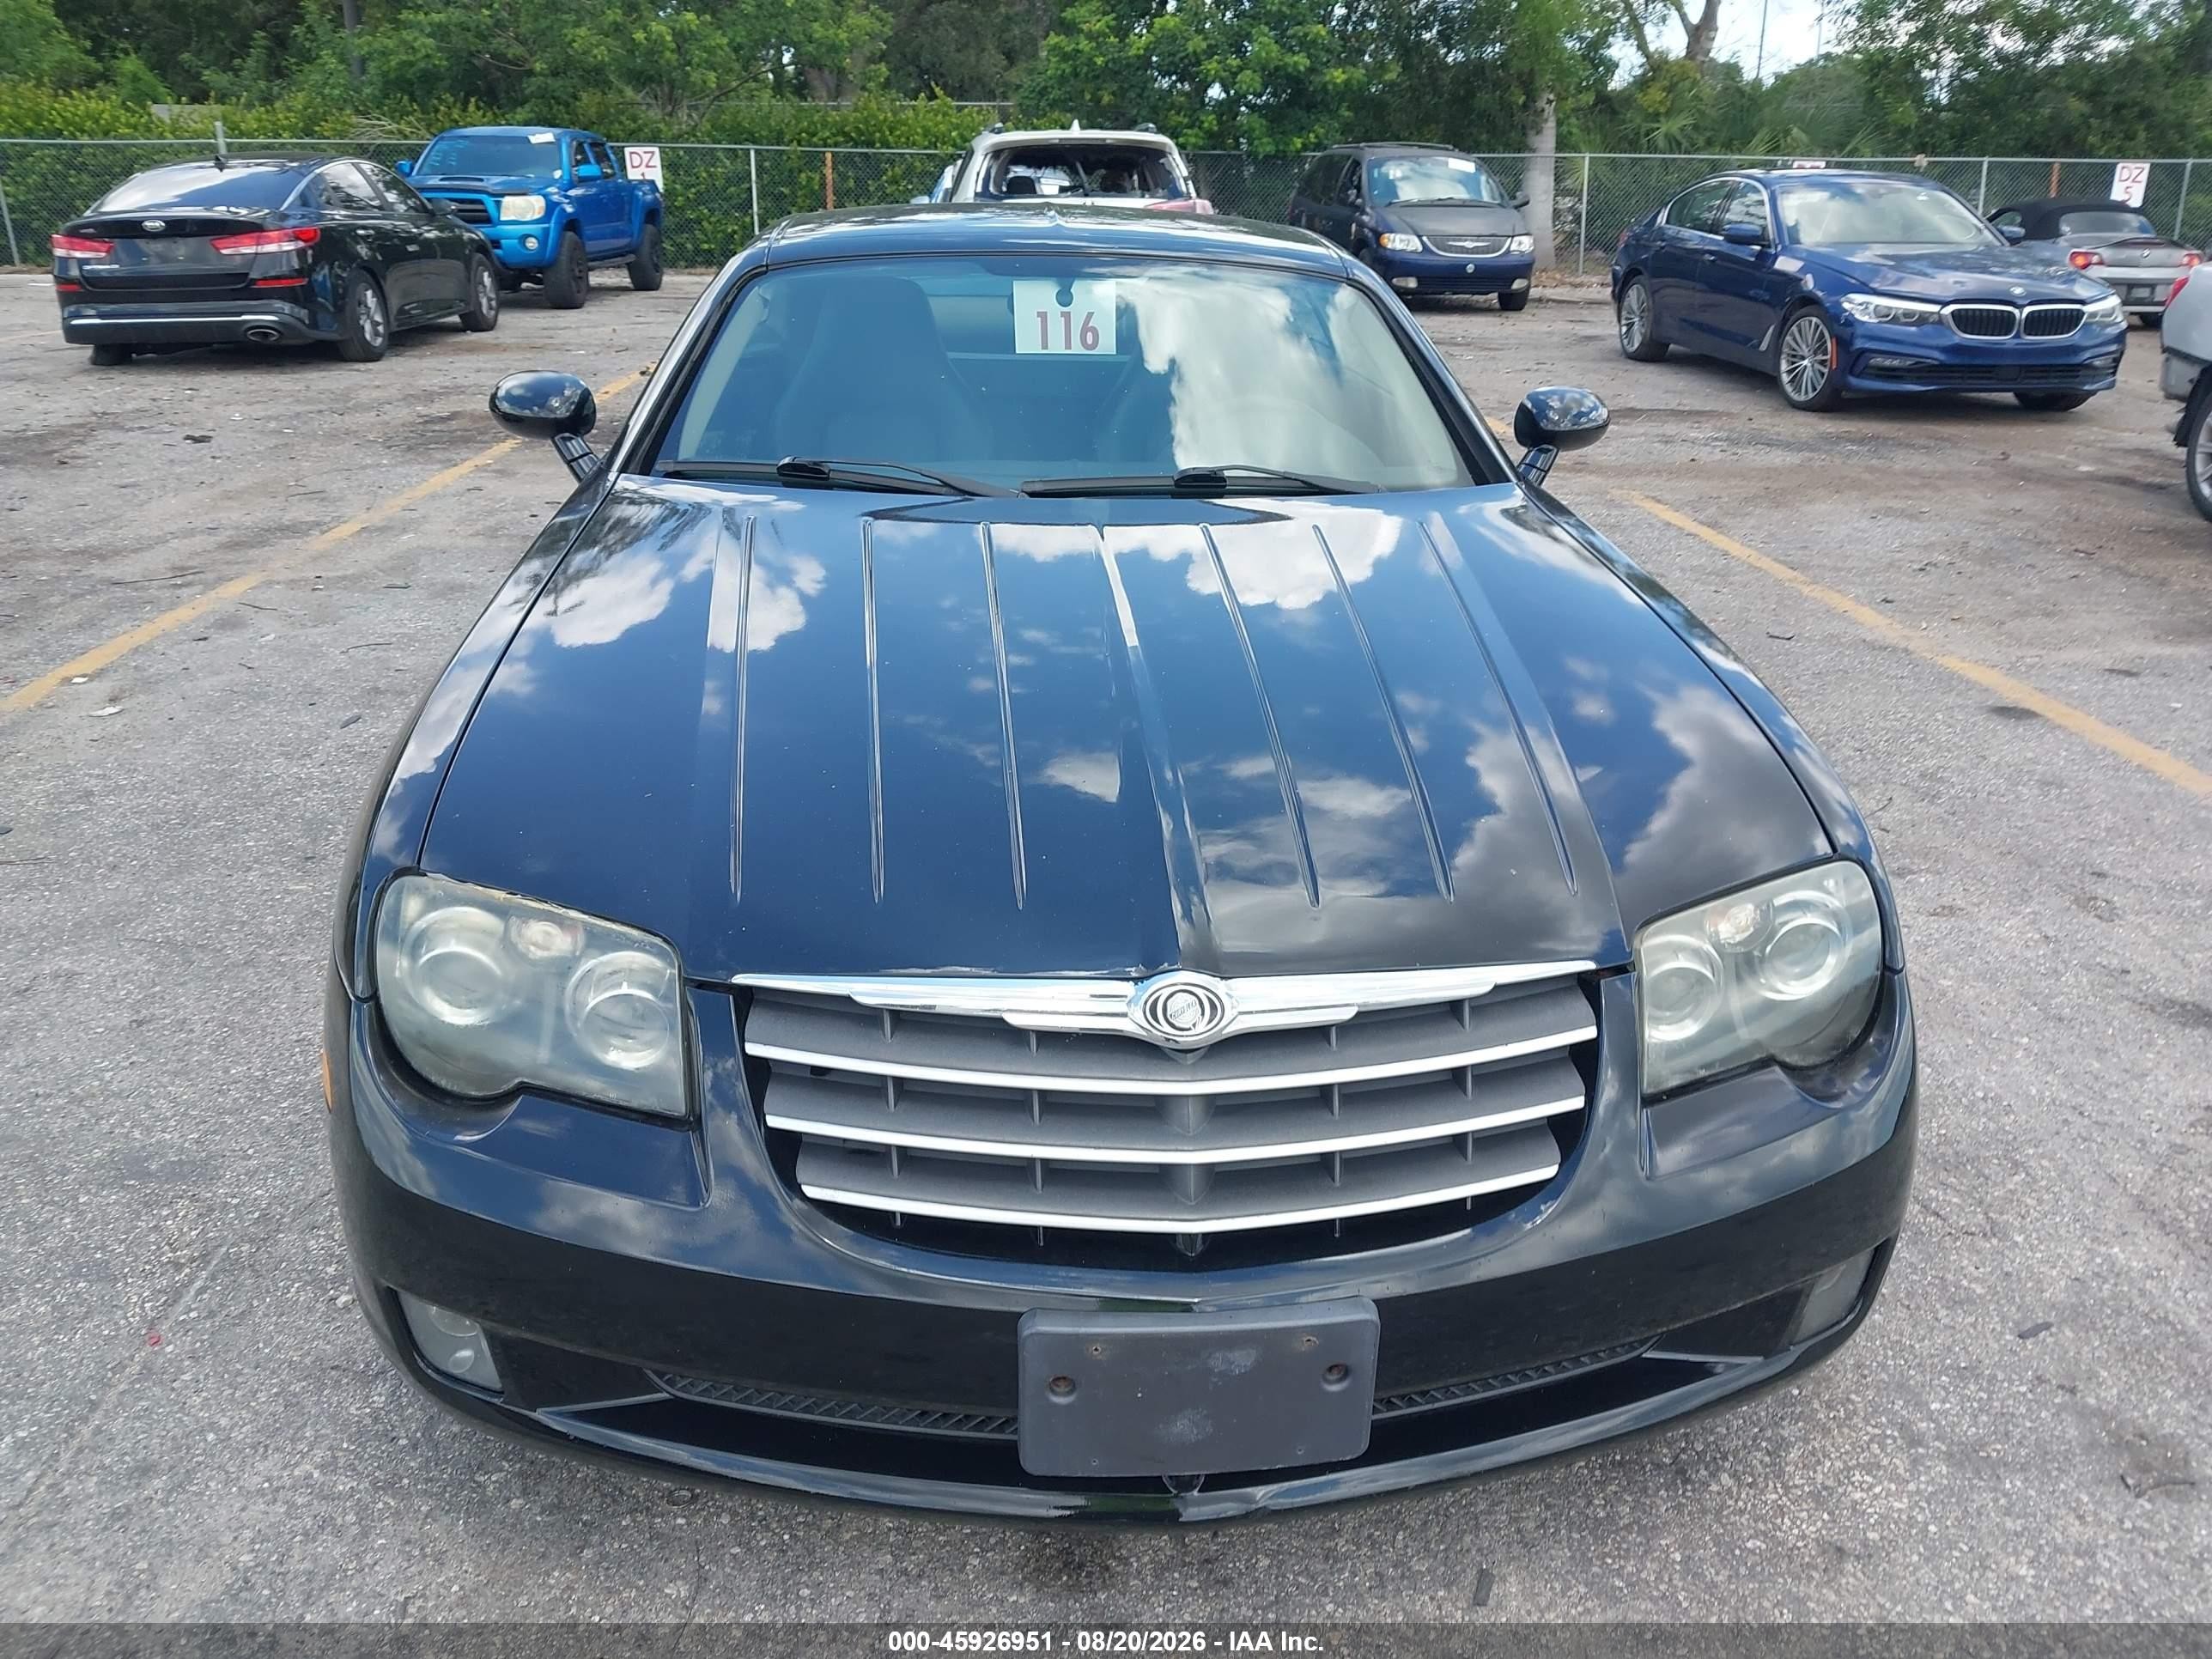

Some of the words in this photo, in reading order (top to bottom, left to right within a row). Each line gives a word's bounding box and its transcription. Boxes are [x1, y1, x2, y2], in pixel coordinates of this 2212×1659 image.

[629, 151, 658, 169] DZ
[2118, 166, 2145, 183] DZ
[1036, 311, 1100, 351] 116
